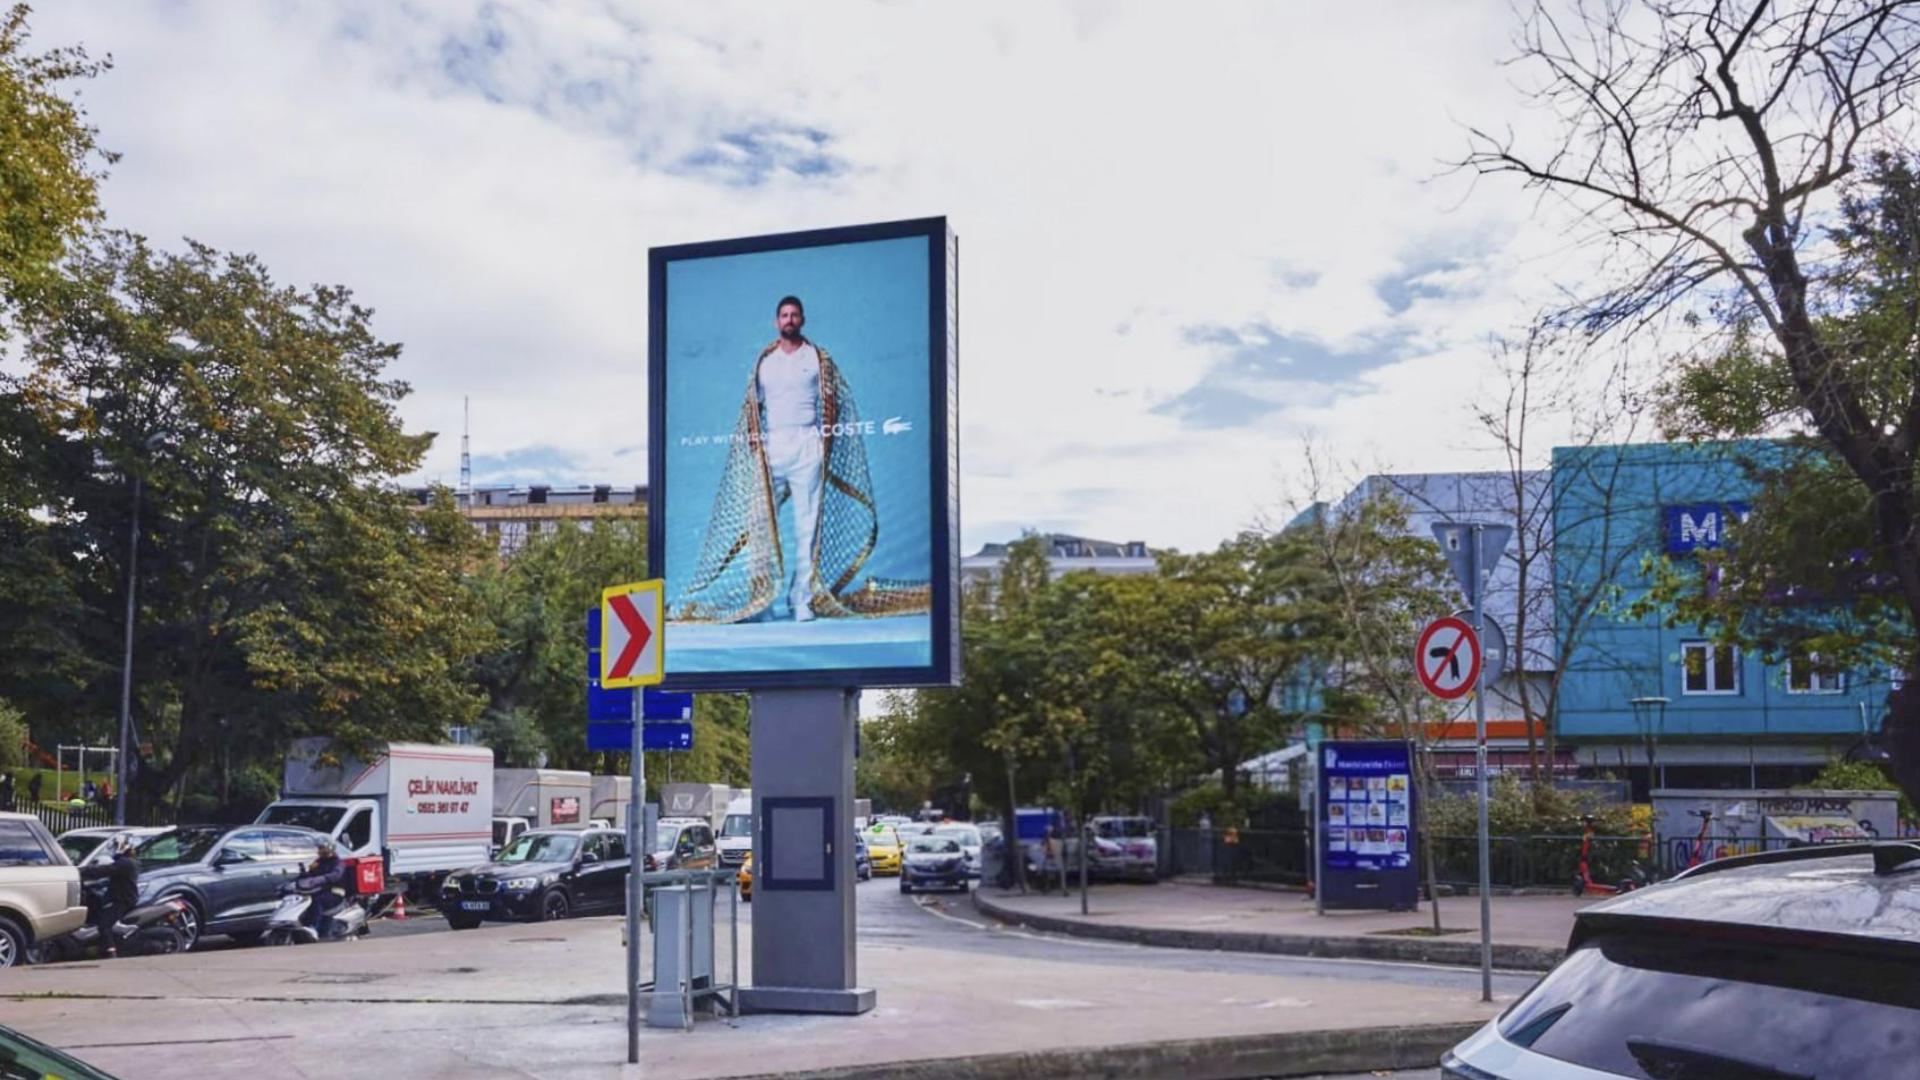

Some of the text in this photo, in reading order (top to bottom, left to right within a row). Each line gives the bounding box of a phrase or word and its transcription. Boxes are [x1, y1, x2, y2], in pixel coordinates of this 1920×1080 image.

[681, 437, 708, 447] PLAY
[408, 776, 478, 797] ÇELİK NAKLİYAT
